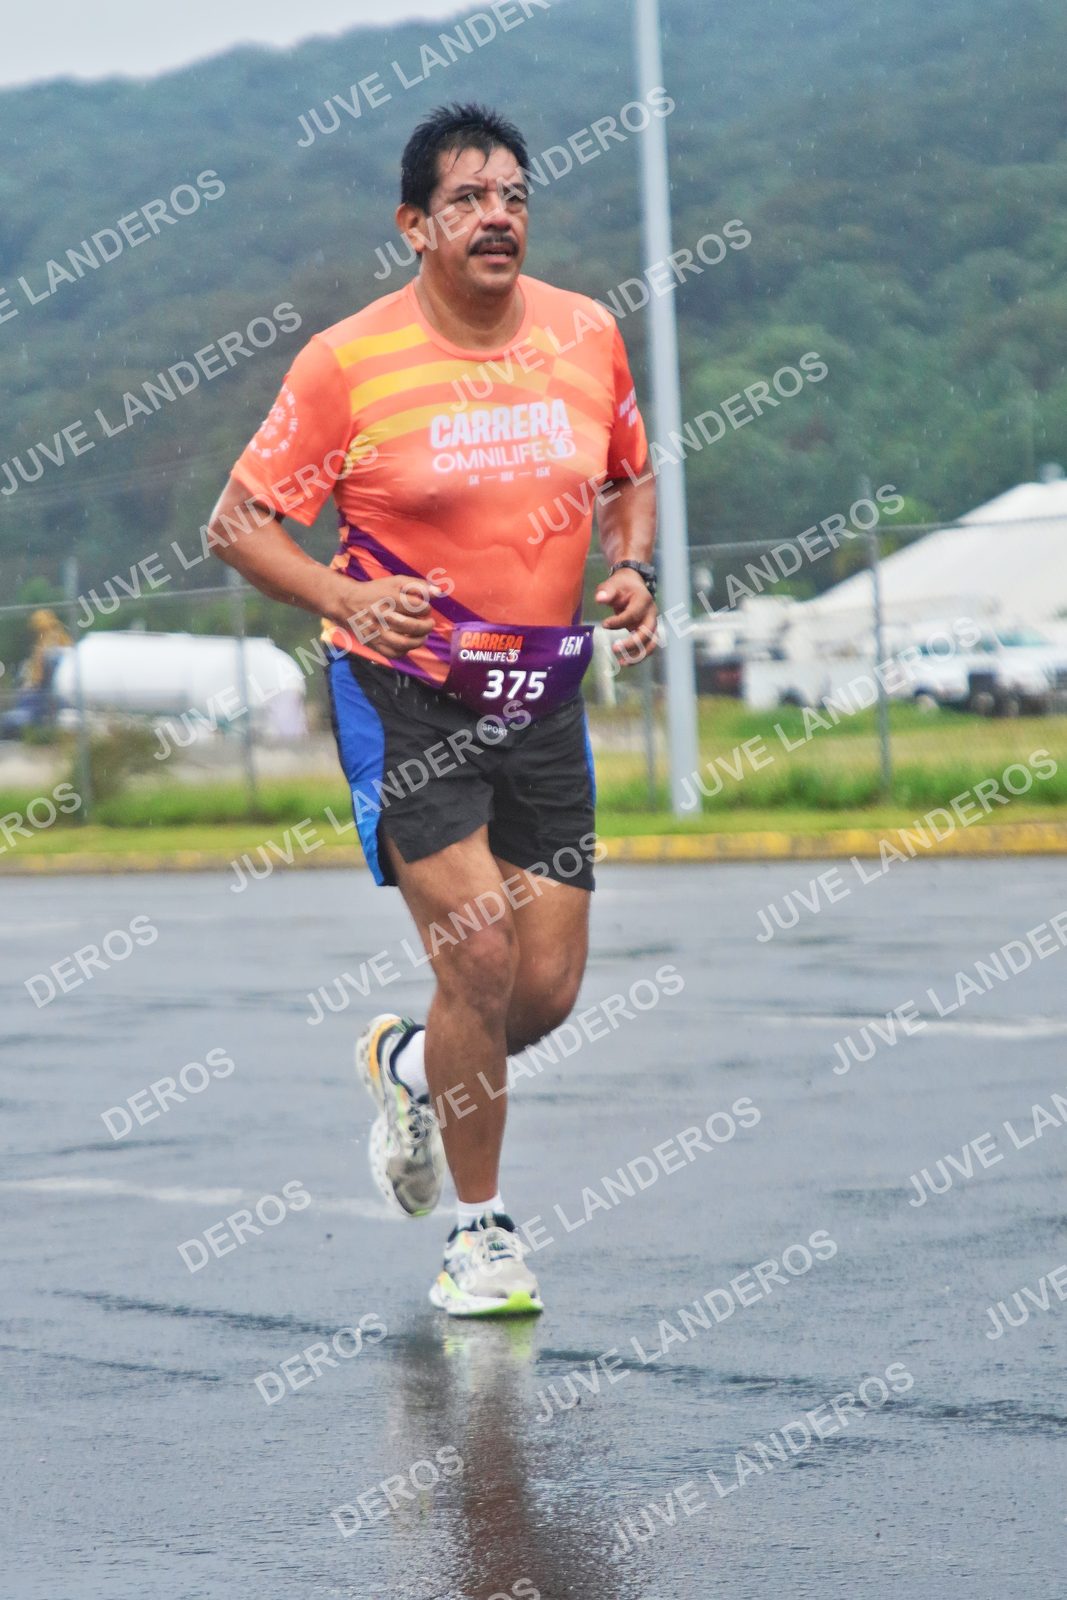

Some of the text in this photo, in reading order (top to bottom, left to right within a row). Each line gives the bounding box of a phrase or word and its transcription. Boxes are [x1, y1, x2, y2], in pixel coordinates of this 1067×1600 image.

[431, 399, 571, 449] CARRERA
[432, 441, 545, 473] OMNILIFE
[460, 632, 524, 651] CARRERA
[557, 636, 584, 656] 15K
[460, 649, 506, 662] OMNILIFE
[482, 669, 547, 700] 375
[482, 723, 508, 736] SPORT
